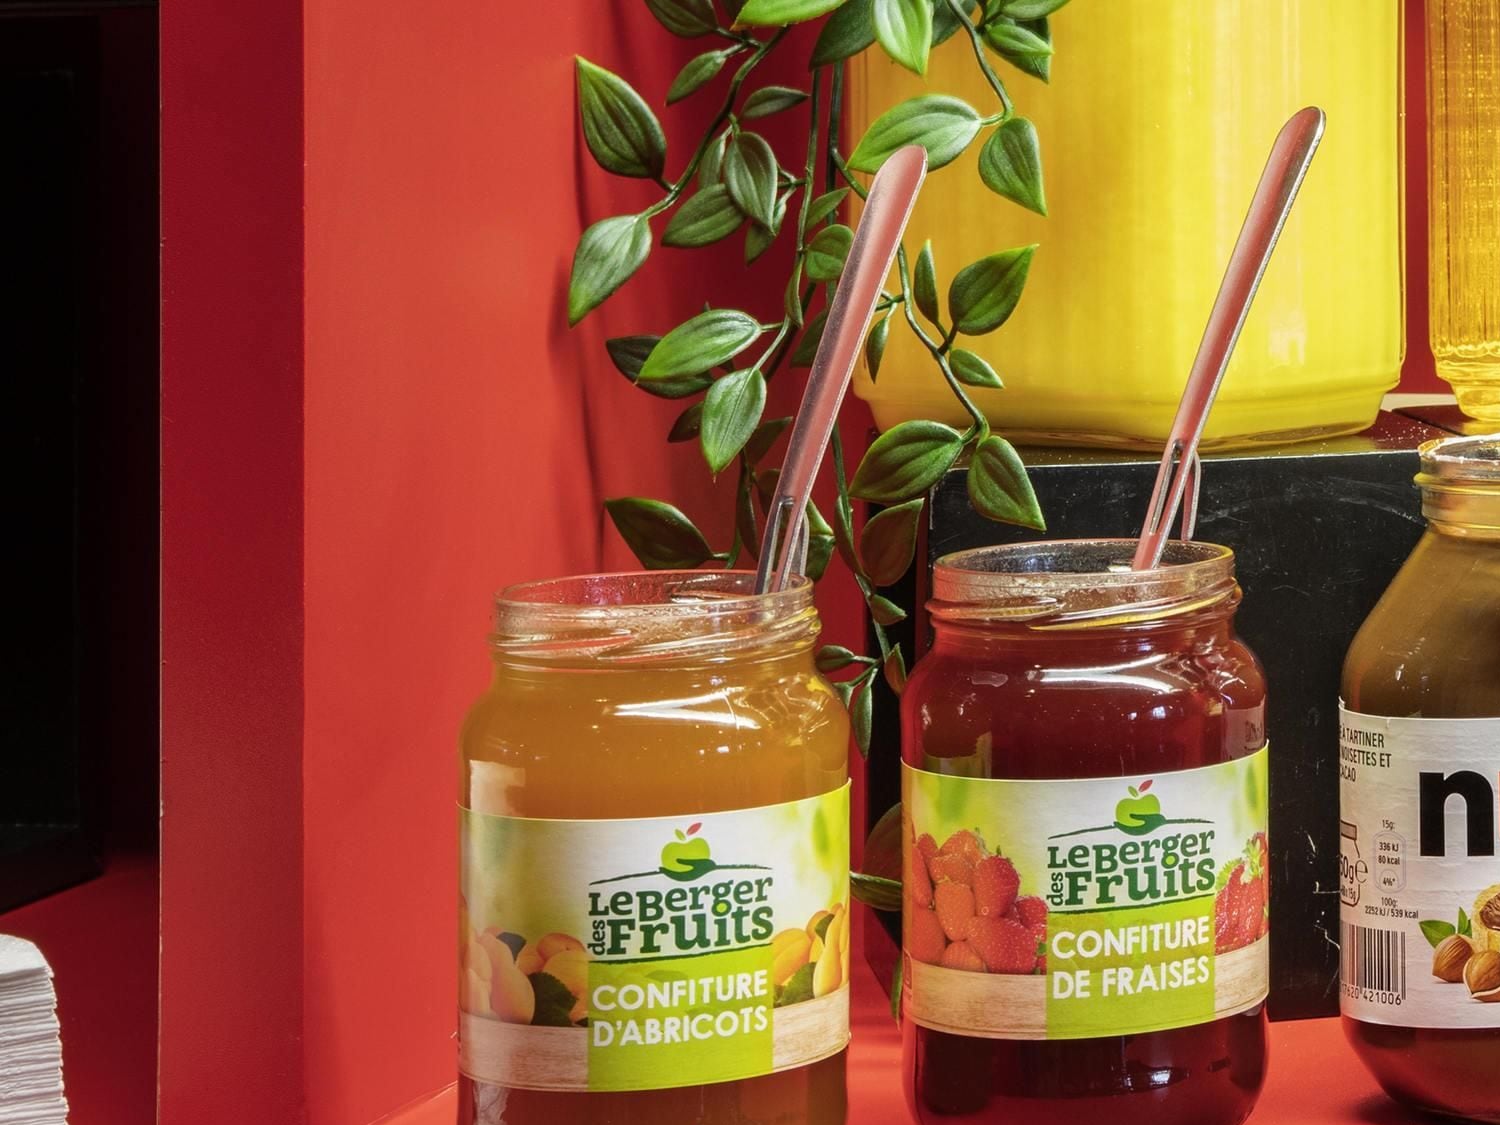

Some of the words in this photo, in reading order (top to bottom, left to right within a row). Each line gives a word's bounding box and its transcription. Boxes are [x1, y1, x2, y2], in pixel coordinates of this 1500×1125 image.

[1346, 727, 1385, 748] TARTINER
[1340, 764, 1357, 782] ACAO
[1379, 752, 1392, 768] ET
[1046, 872, 1064, 907] des
[1065, 857, 1216, 906] Fruits
[587, 920, 606, 956] des
[606, 905, 774, 956] Fruits
[1404, 910, 1419, 919] kcal
[1051, 915, 1210, 960] CONFITURE
[592, 969, 768, 1012] CONFITURE
[1052, 969, 1091, 1000] DE
[1102, 955, 1210, 997] FRAISES
[1363, 990, 1402, 1006] 421006
[592, 1006, 768, 1048] D'ABRICOTS
